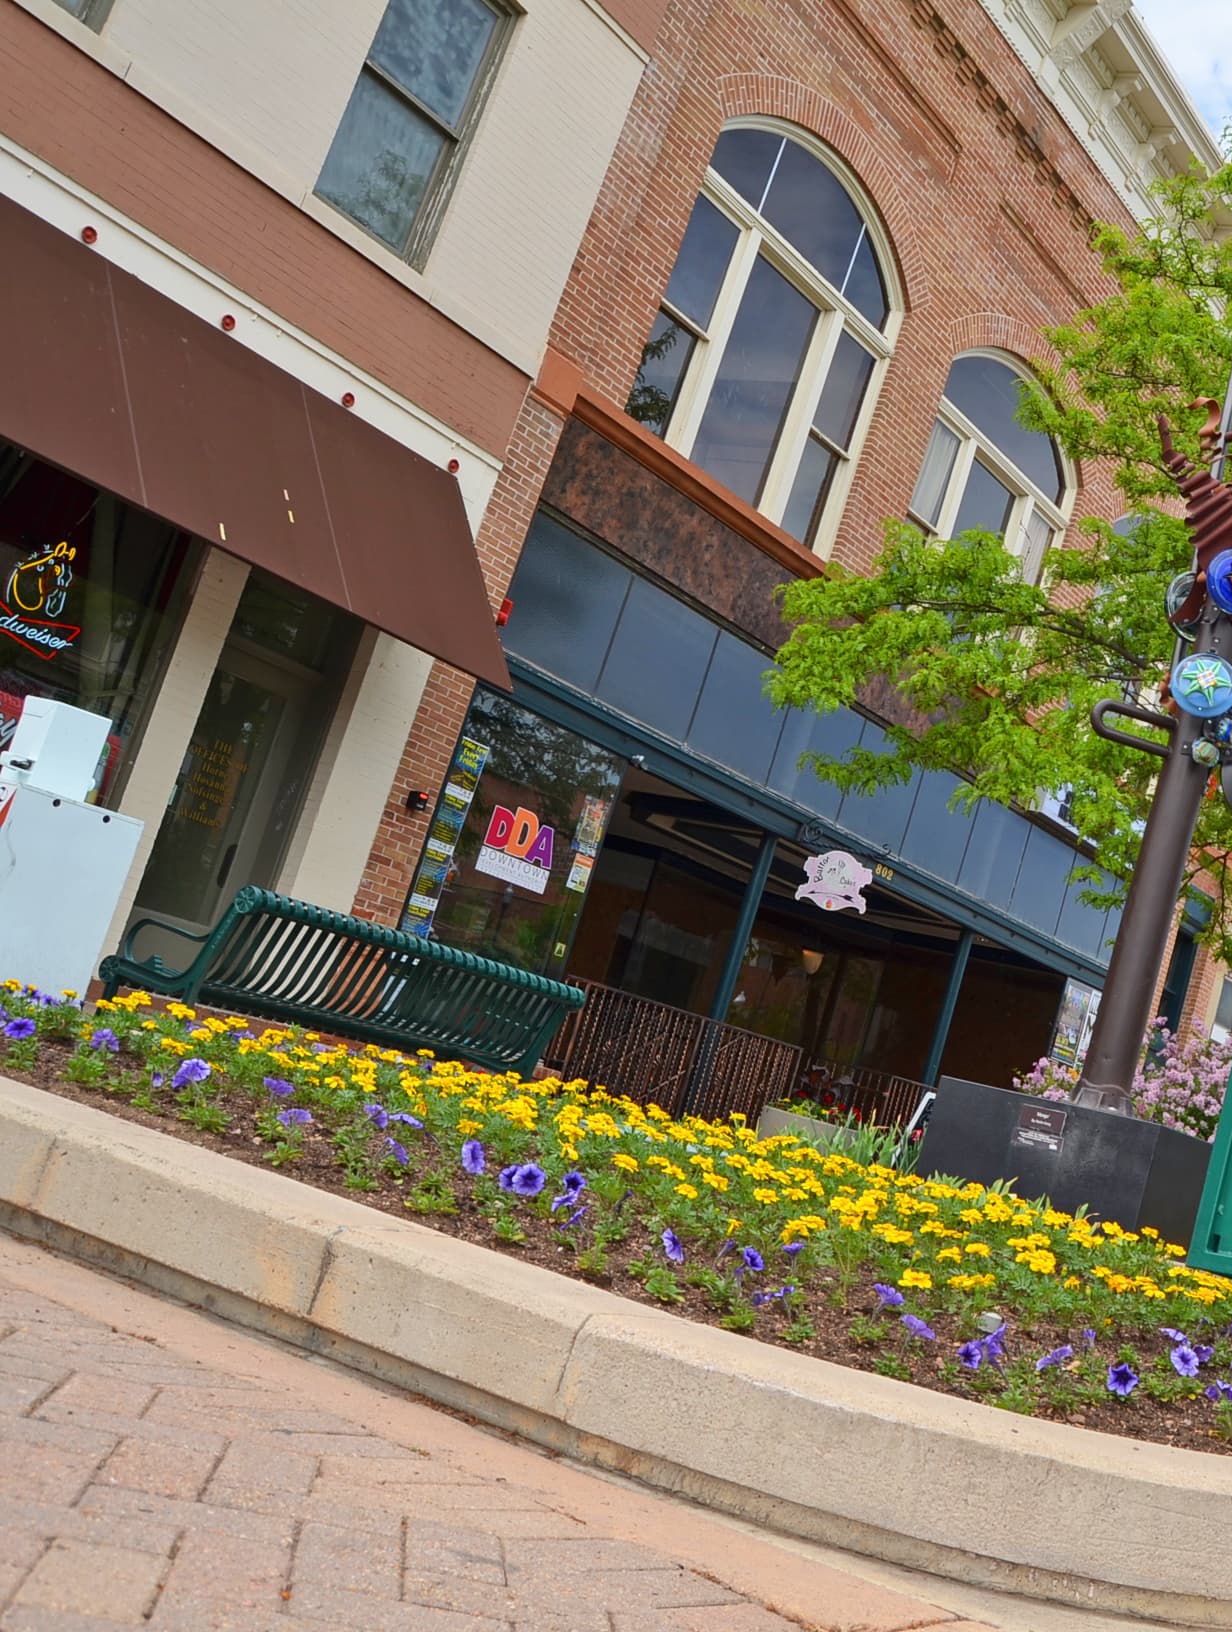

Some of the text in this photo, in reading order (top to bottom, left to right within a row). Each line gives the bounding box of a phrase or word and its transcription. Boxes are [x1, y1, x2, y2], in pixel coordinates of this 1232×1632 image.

[483, 805, 554, 870] DDA
[480, 847, 548, 880] DOWNTOWN
[875, 863, 894, 880] 802
